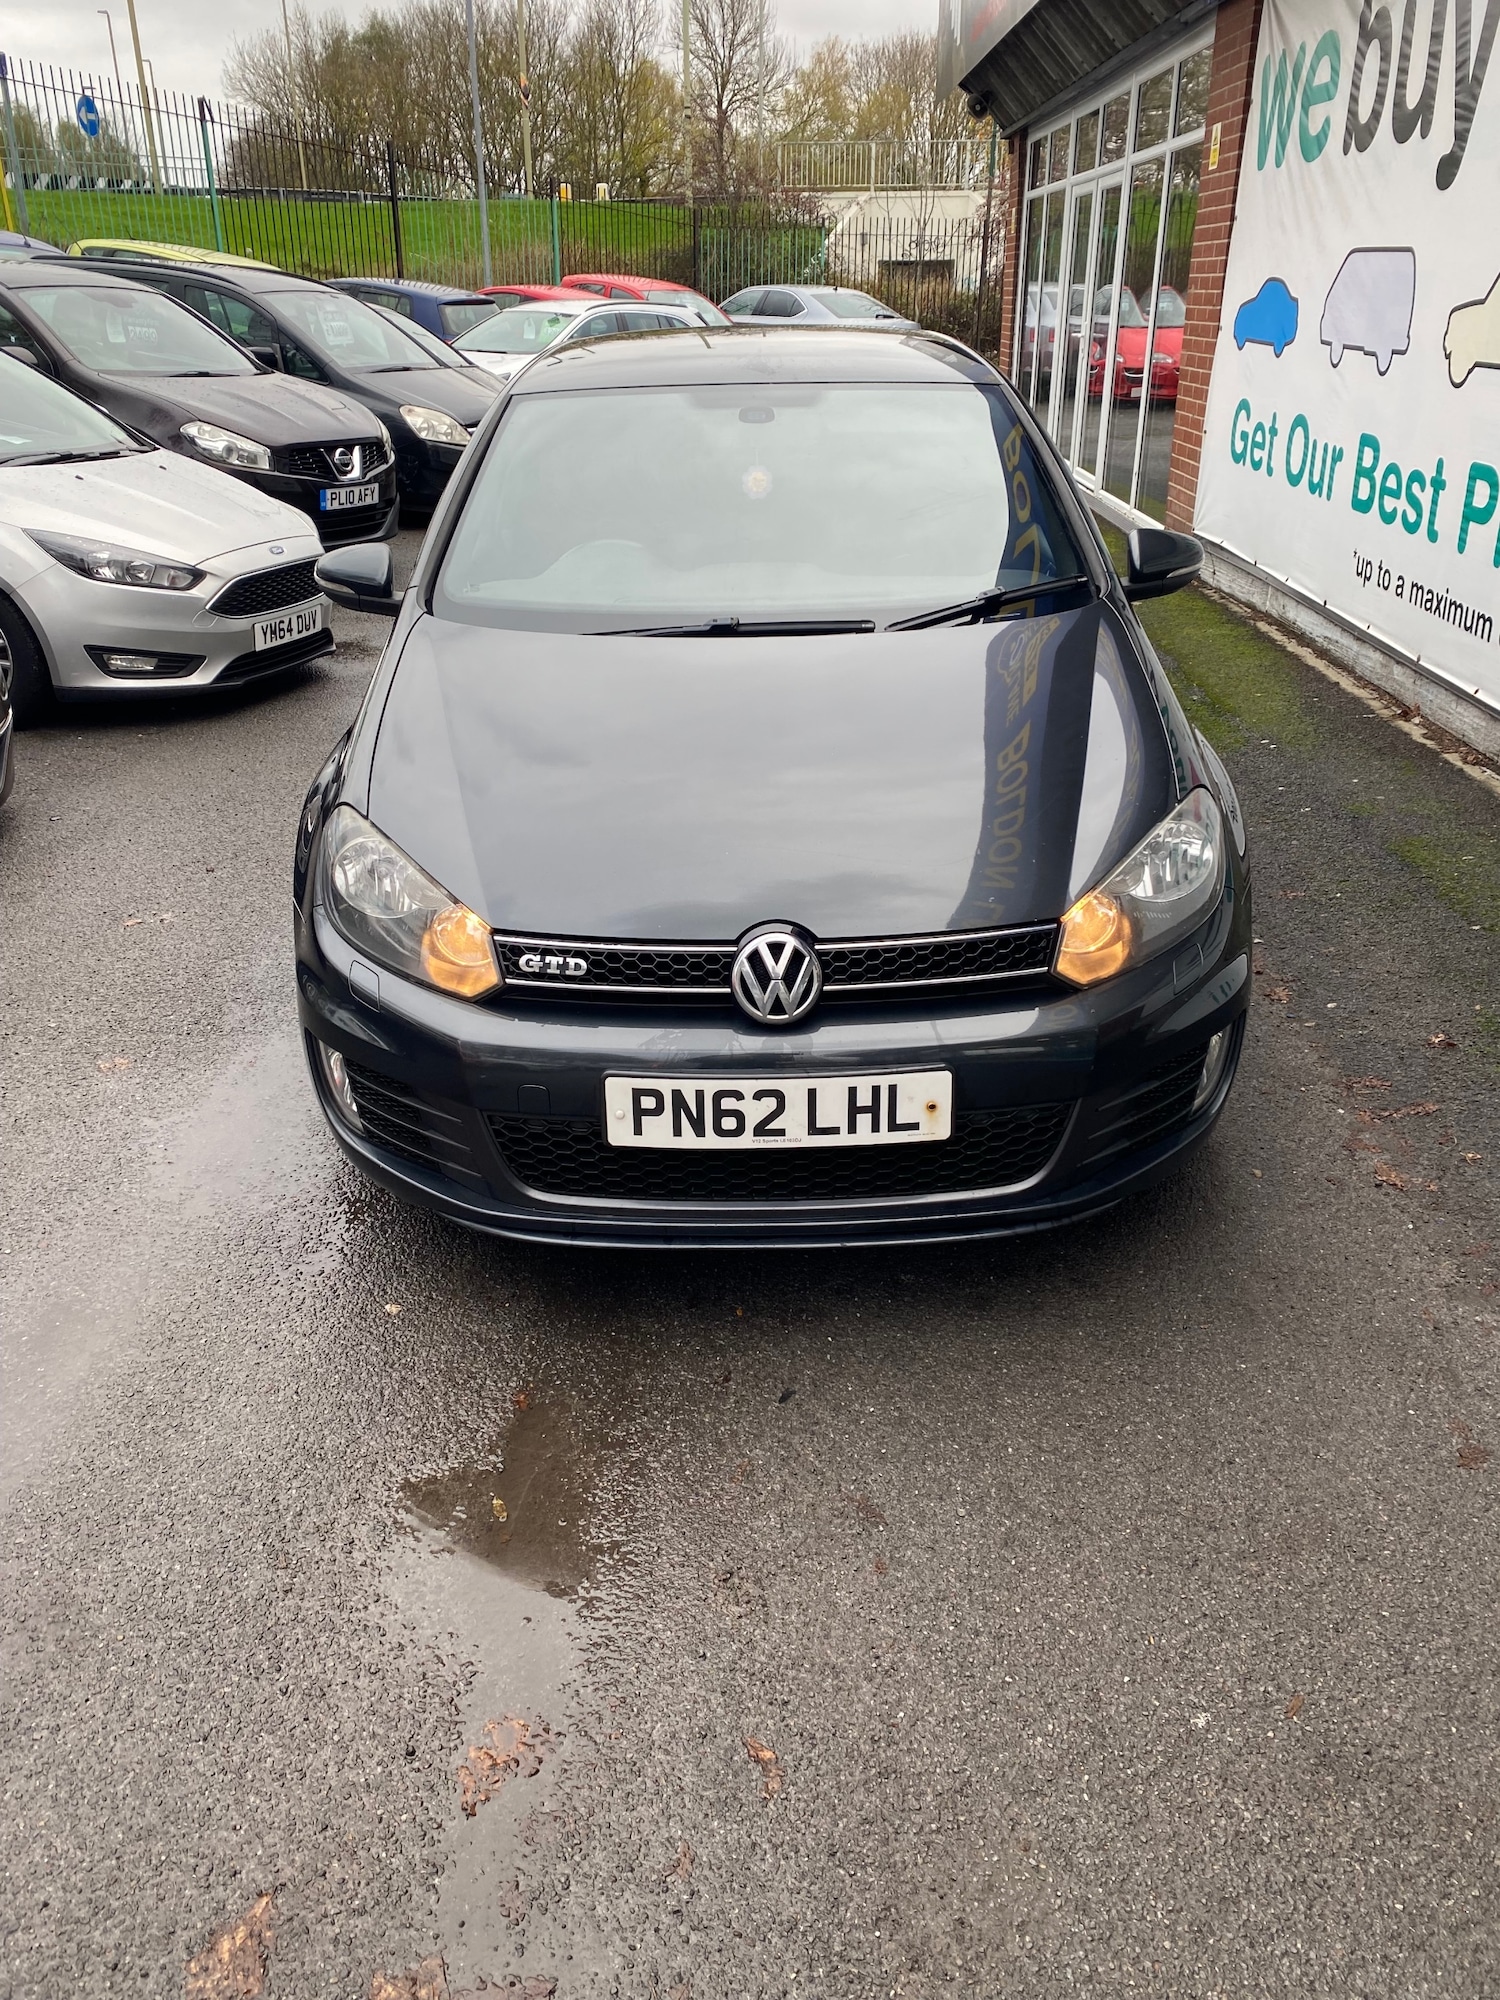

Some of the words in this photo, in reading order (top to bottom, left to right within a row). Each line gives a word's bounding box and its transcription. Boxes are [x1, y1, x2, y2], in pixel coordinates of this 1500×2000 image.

[1257, 29, 1341, 171] we
[1343, 0, 1500, 191] buy
[330, 489, 355, 507] PL10
[357, 486, 376, 504] AFY
[1230, 398, 1278, 477] Get
[1285, 413, 1344, 501] Our
[1351, 432, 1447, 543] Best
[261, 617, 294, 645] YM64
[296, 609, 317, 635] DUV
[1377, 559, 1392, 591] to
[1395, 574, 1405, 599] a
[1409, 580, 1494, 643] maximum
[518, 953, 588, 976] GTD
[631, 1087, 786, 1137] PN62
[807, 1083, 920, 1135] LHL
